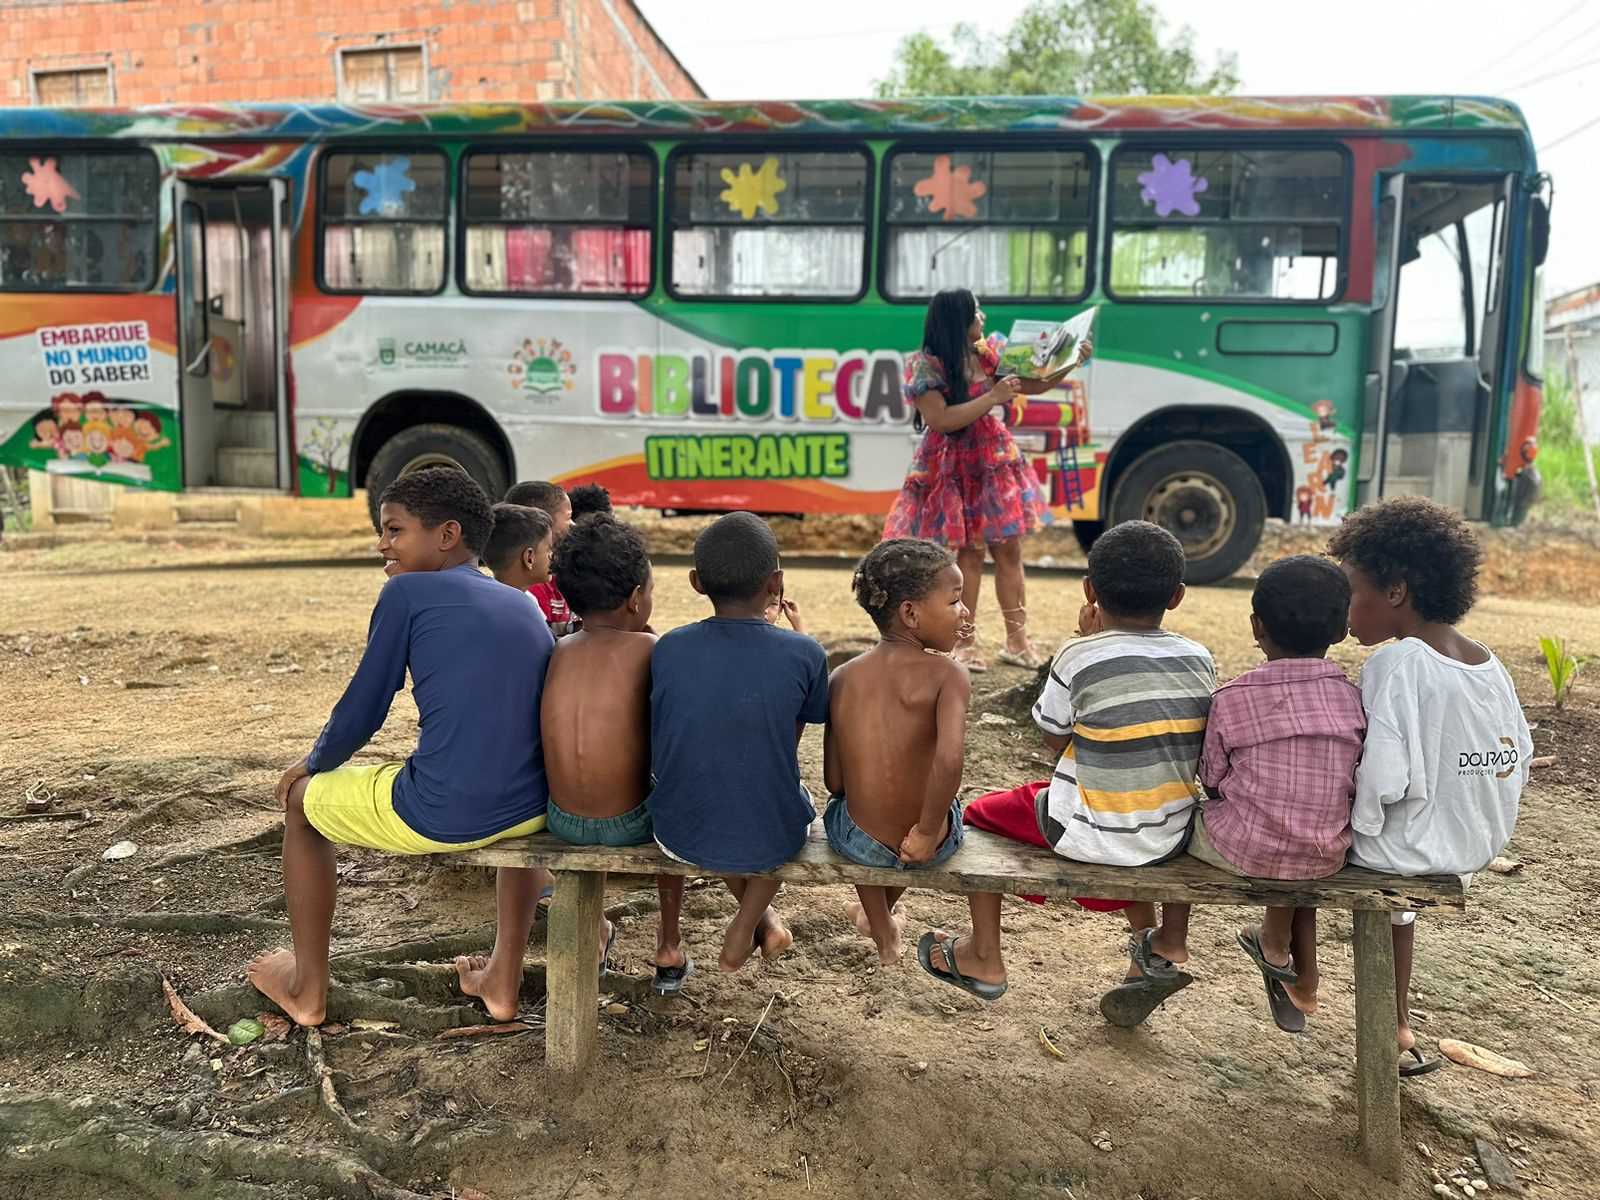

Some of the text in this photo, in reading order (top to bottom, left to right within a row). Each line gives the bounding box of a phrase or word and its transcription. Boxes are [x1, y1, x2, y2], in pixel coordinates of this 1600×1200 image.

[41, 324, 146, 346] EMBARQUE
[45, 345, 148, 366] NO MUNDO
[50, 364, 150, 385] DO SABER!
[598, 354, 905, 420] BIBLIOTECA
[646, 433, 848, 479] ITINERANTE
[1459, 749, 1518, 767] DOURADO
